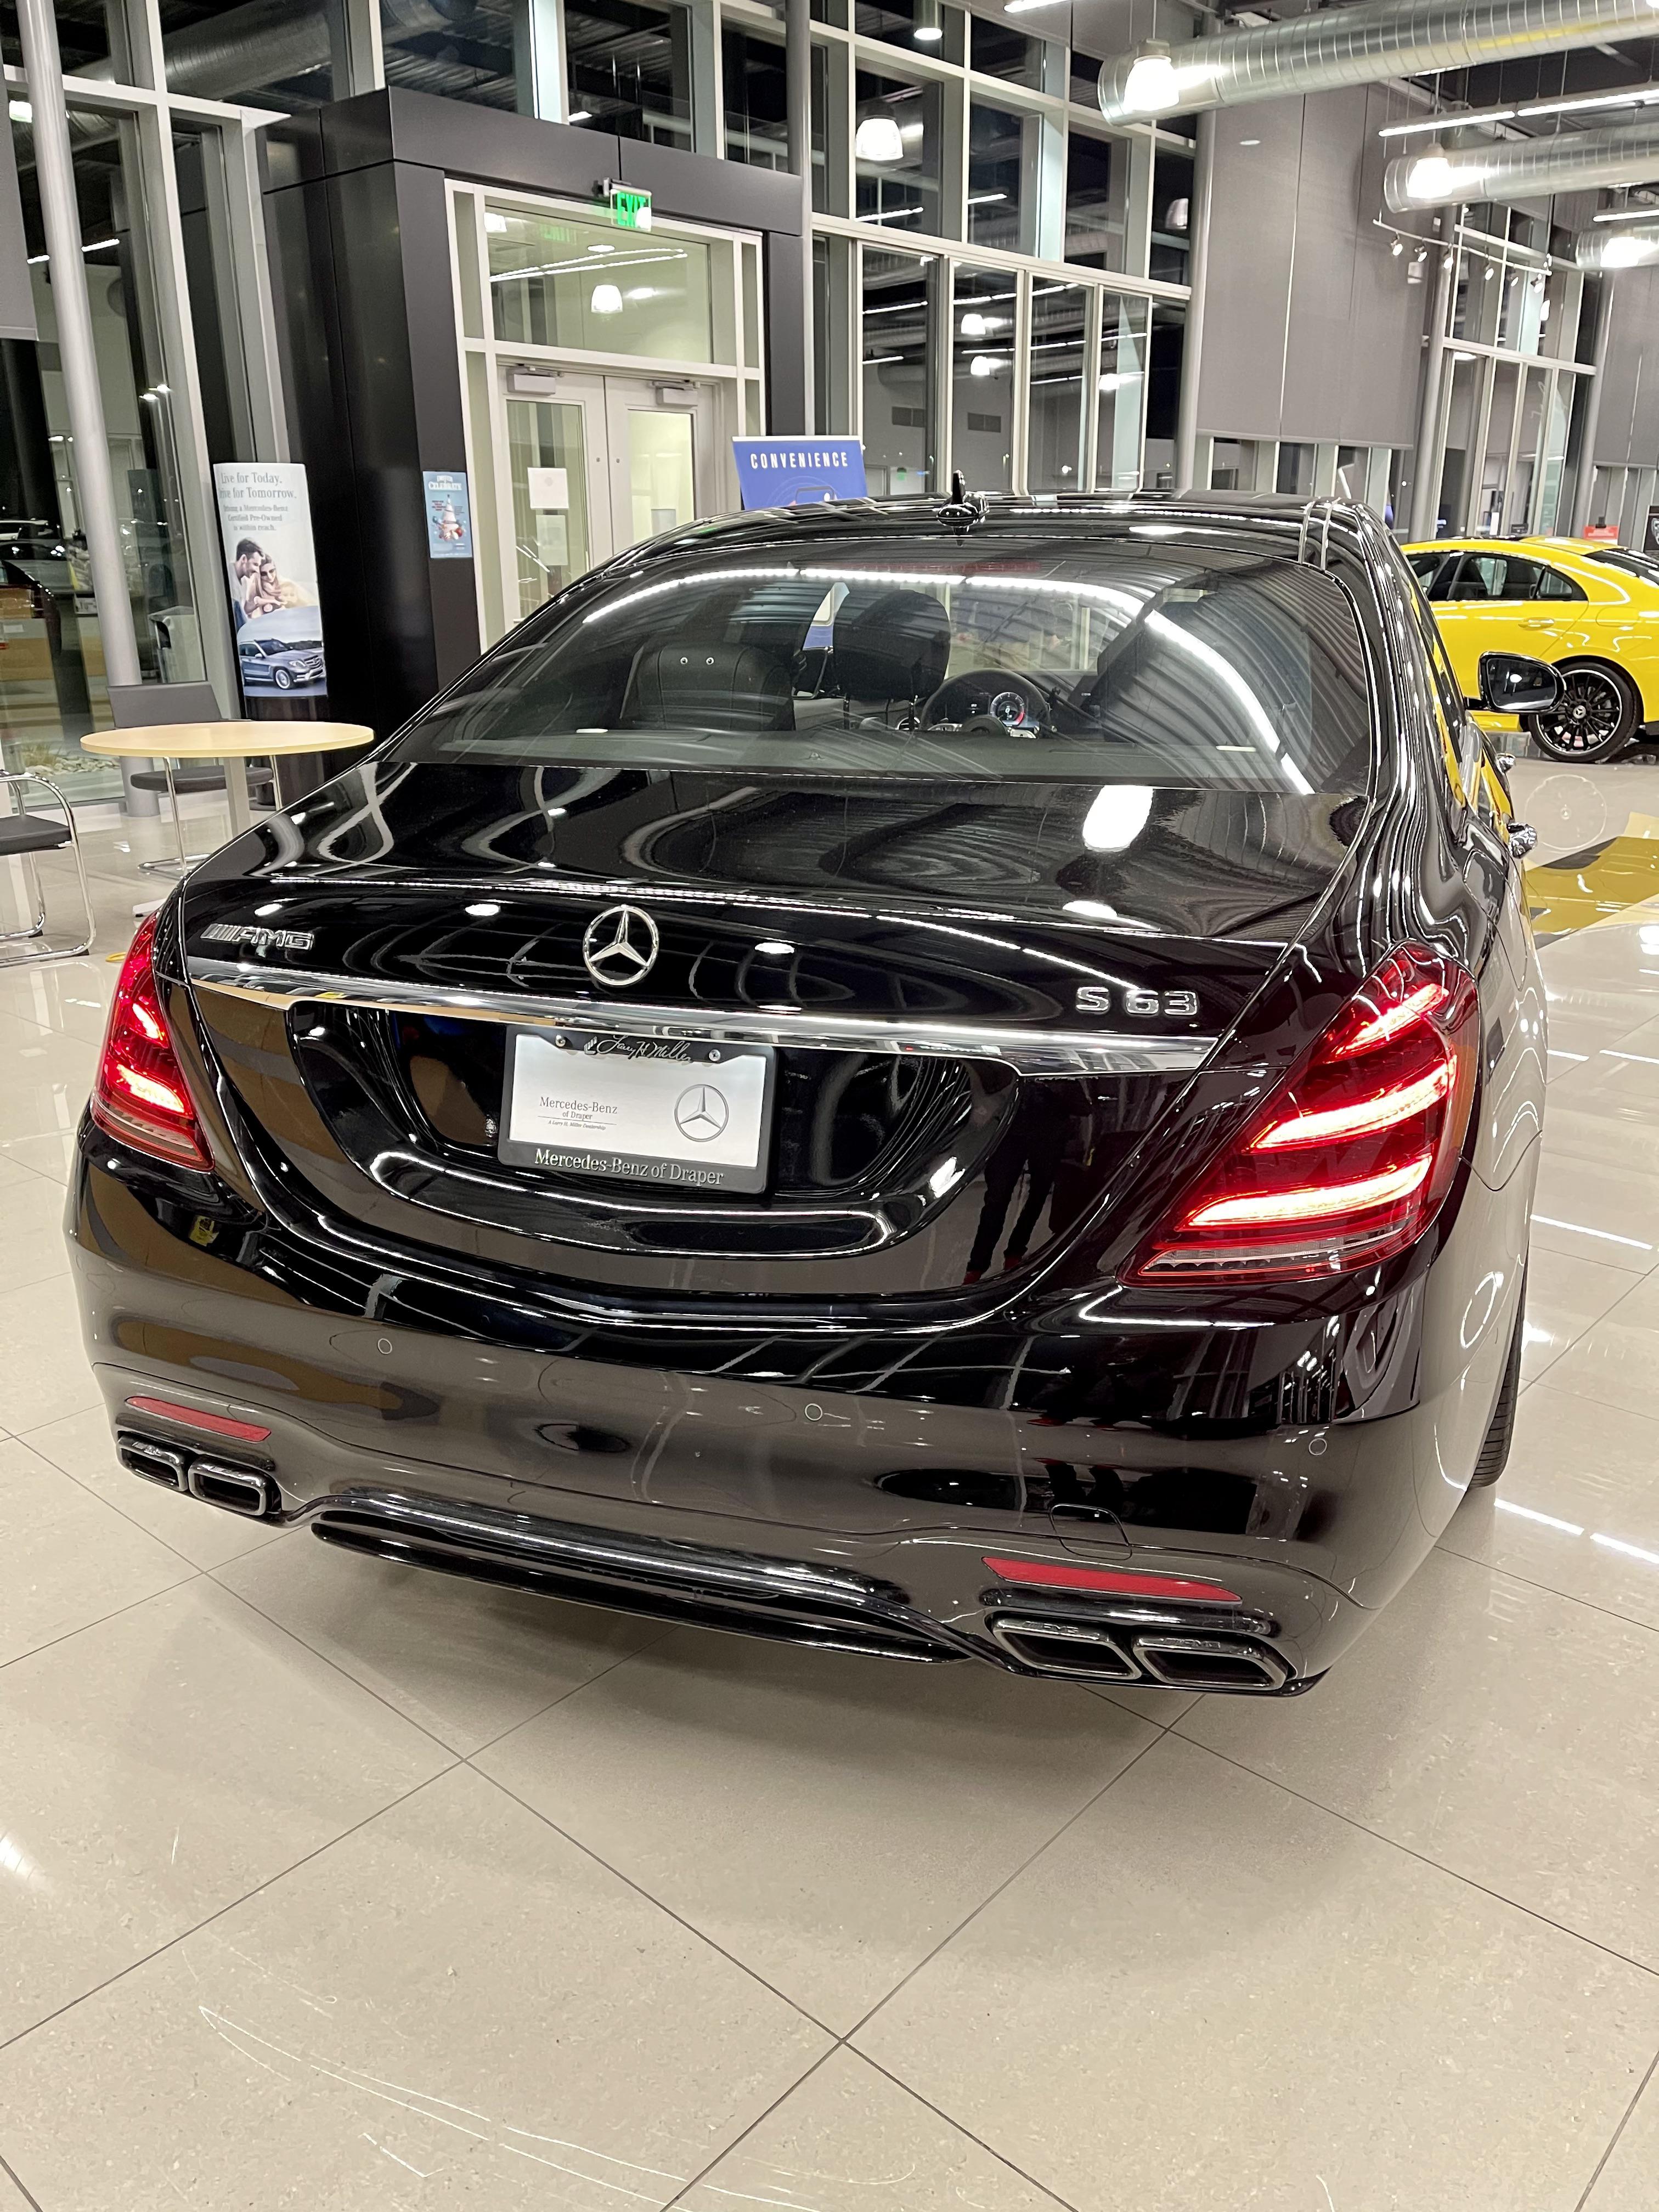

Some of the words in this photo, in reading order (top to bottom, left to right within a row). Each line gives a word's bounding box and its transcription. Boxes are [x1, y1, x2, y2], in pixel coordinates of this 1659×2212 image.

[750, 452, 848, 470] CONVENIENCE
[221, 472, 235, 484] Live
[236, 472, 249, 483] for
[250, 472, 283, 486] Today.
[233, 487, 244, 499] for
[246, 487, 297, 499] Tomorrow.
[231, 926, 315, 951] AMG
[1075, 986, 1110, 1013] S
[1126, 989, 1198, 1016] 63
[596, 1035, 636, 1059] Larry
[647, 1041, 694, 1063] Miller
[539, 1096, 618, 1114] Mercedes-Benz
[571, 1111, 593, 1122] Draper
[534, 1148, 648, 1177] Mercedes-Benz
[651, 1163, 668, 1178] of
[669, 1164, 725, 1187] Draper
